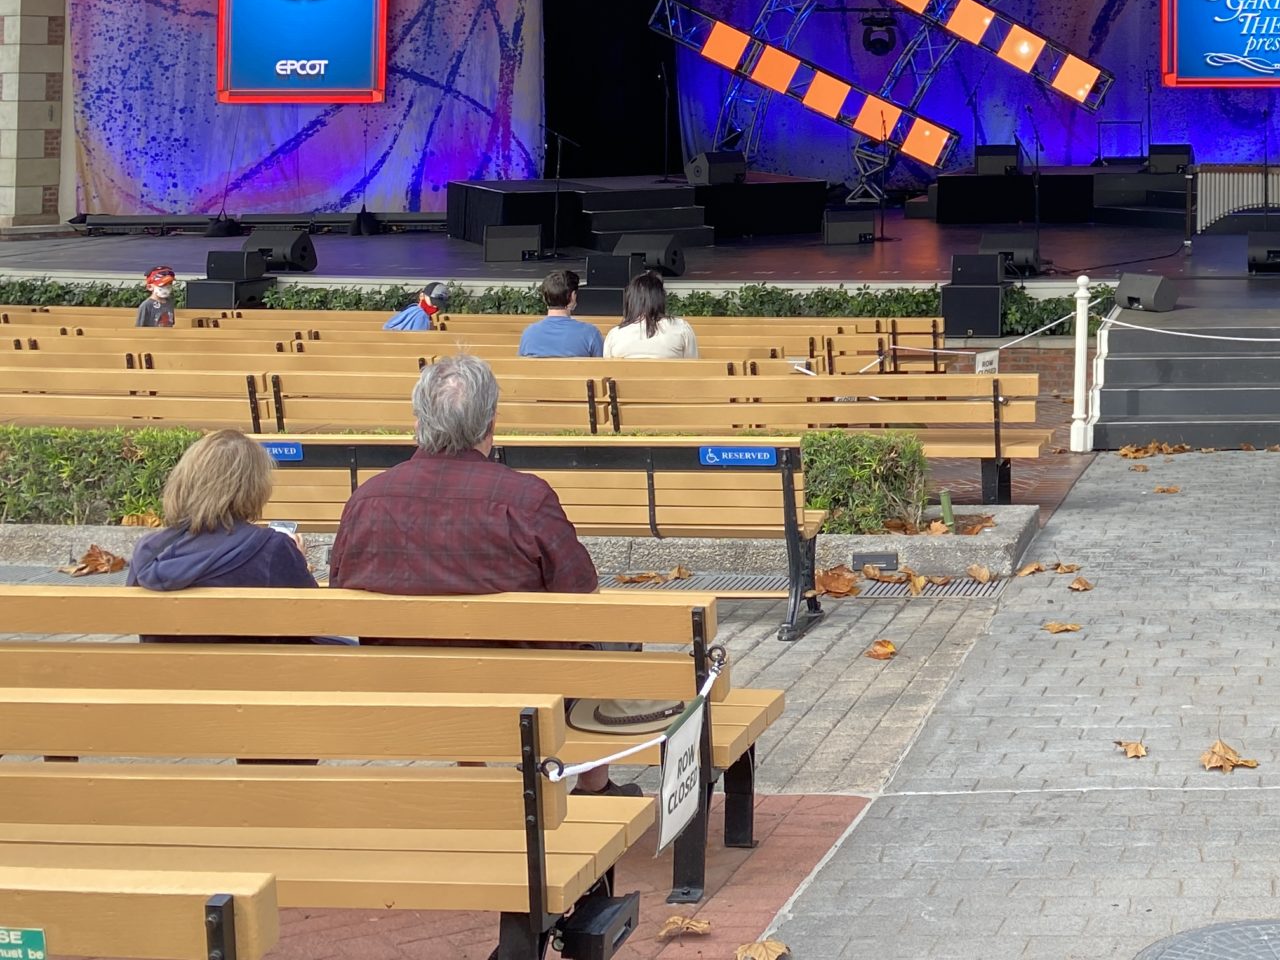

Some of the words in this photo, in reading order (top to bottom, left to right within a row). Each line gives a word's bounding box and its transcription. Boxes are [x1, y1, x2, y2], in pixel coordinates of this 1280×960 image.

[275, 59, 328, 75] EPCOT
[266, 447, 297, 455] ERVED
[721, 452, 770, 460] RESERVED
[677, 743, 695, 779] ROW
[28, 948, 44, 959] be
